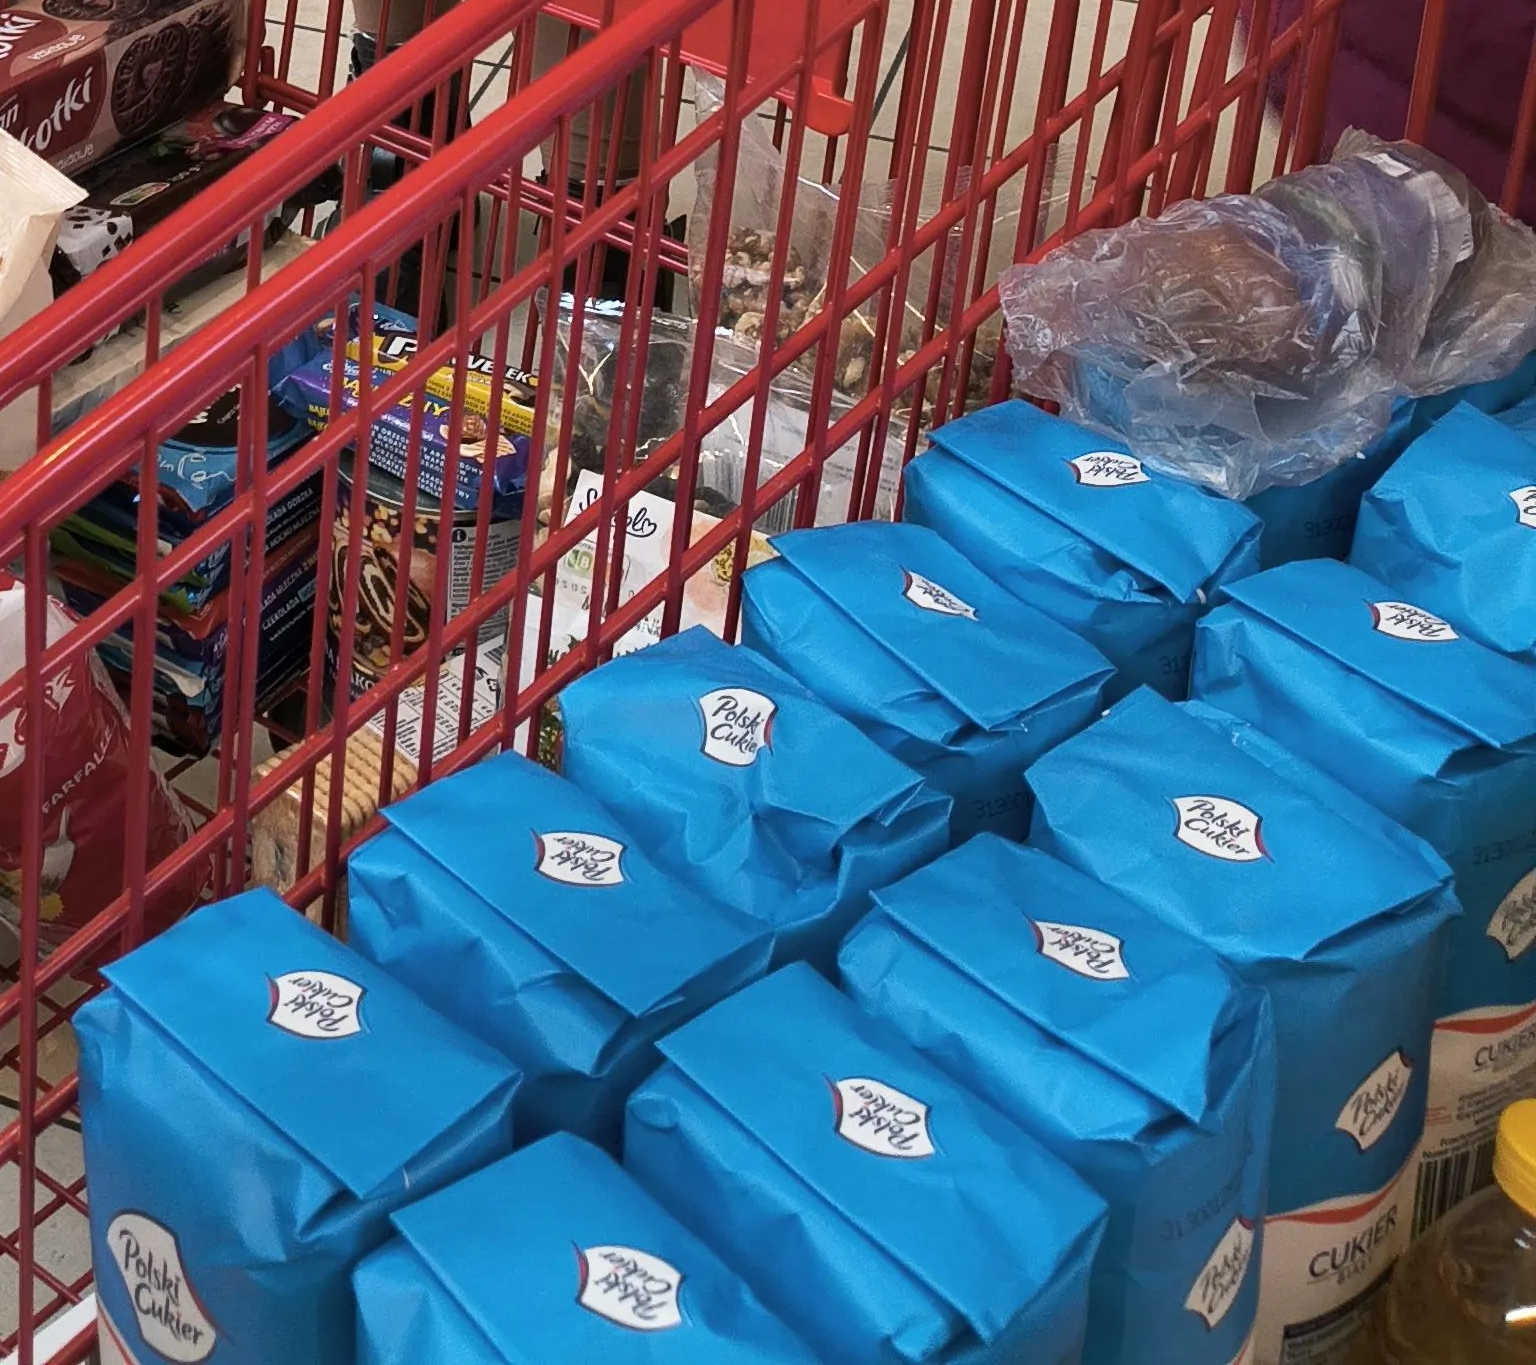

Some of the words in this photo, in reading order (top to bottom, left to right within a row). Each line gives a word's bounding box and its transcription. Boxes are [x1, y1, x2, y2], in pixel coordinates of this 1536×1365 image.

[712, 695, 765, 735] Polski
[710, 723, 758, 755] Cukie
[41, 725, 113, 814] FARFALLE
[1183, 818, 1251, 856] Cukier
[1192, 799, 1250, 839] Polski
[549, 850, 613, 882] Polski
[553, 836, 616, 864] Cukier
[1049, 937, 1115, 975] Polski
[288, 976, 354, 1009] Cukier
[284, 993, 349, 1033] Polski
[849, 1082, 922, 1126] Cukier
[848, 1101, 920, 1151] Polski
[1308, 1204, 1398, 1279] CUKIER
[118, 1228, 183, 1306] Polski
[133, 1282, 205, 1347] Cukier
[595, 1271, 670, 1321] Polski
